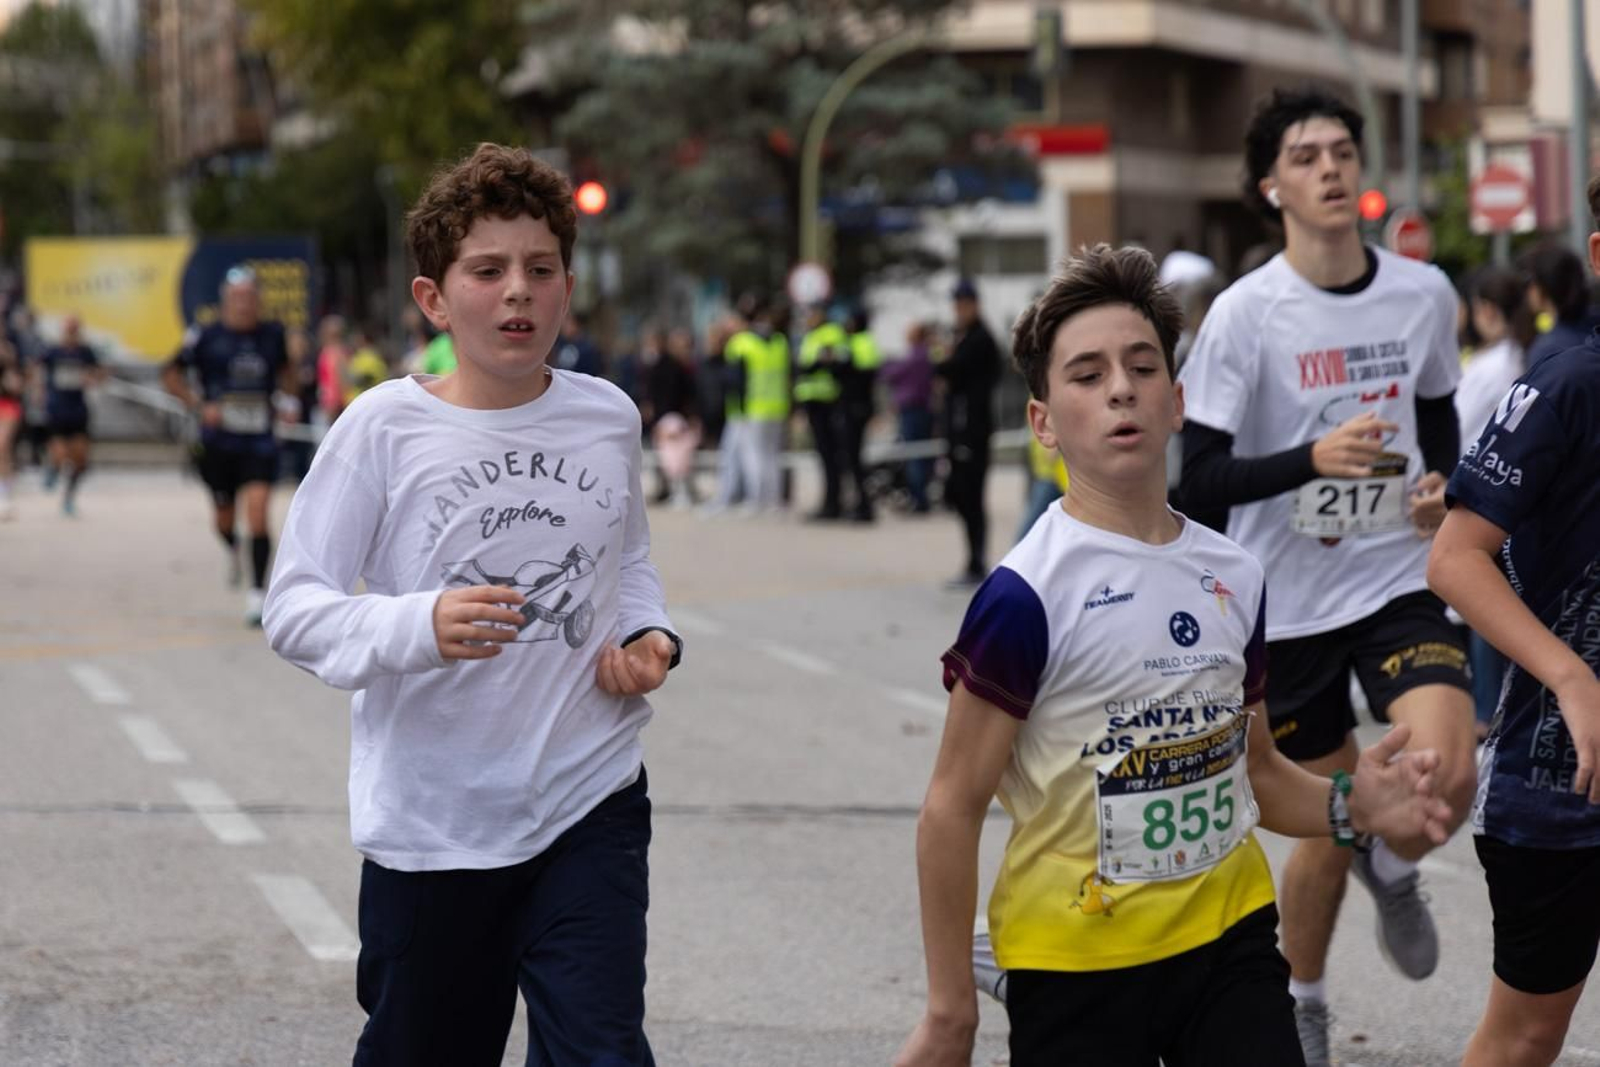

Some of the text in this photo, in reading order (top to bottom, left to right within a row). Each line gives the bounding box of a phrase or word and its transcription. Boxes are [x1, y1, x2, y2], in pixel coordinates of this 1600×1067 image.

[1317, 484, 1387, 516] 217
[480, 500, 566, 539] Explore
[1143, 655, 1181, 671] PABLO
[1107, 706, 1195, 734] SANTA
[1081, 735, 1135, 759] LOS
[1150, 738, 1211, 761] CARRERA
[1168, 753, 1204, 773] gran
[1143, 777, 1234, 850] 855
